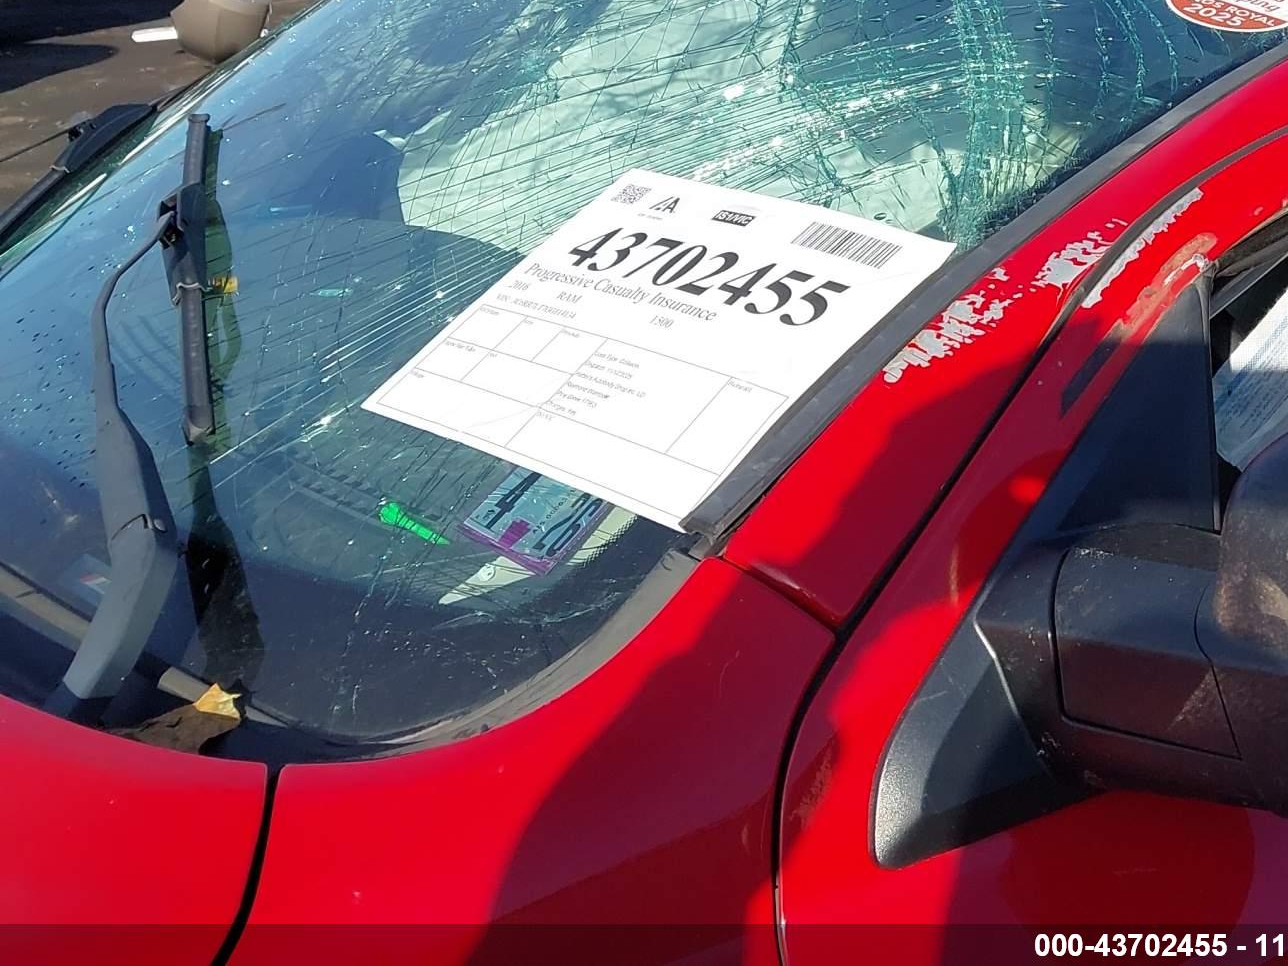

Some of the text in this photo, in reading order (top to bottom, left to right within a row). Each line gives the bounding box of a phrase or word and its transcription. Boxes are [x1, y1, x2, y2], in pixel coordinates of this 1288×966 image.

[1183, 3, 1246, 26] 2025
[1225, 5, 1275, 27] ROYAL
[568, 227, 851, 326] 43702455
[524, 263, 718, 321] Progressive Casualty Insurance
[556, 291, 582, 304] RAM
